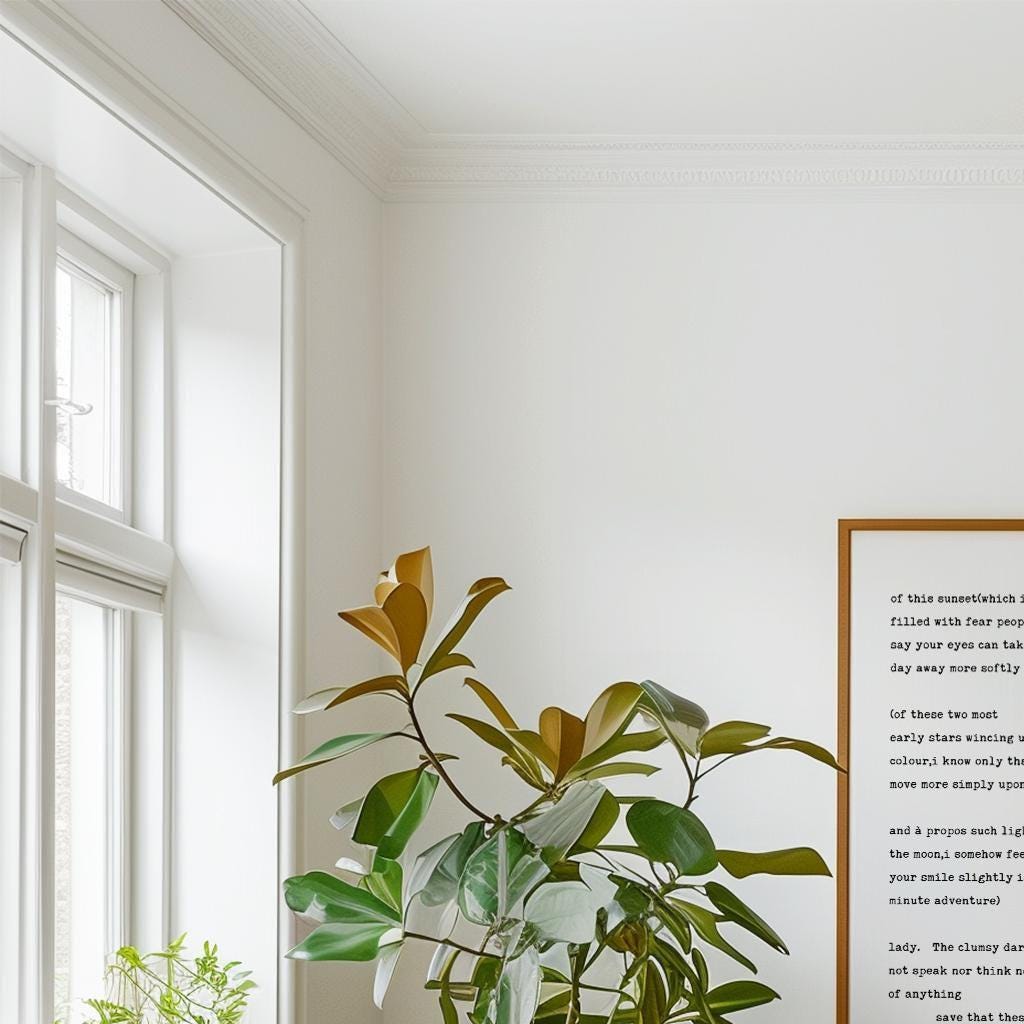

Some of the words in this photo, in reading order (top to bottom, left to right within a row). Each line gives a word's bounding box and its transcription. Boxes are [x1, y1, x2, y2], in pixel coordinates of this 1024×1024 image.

[890, 593, 904, 604] of
[907, 593, 934, 604] this
[937, 592, 1016, 604] sunset(which
[890, 616, 931, 627] filled
[933, 616, 962, 627] with
[965, 616, 993, 627] fear
[890, 640, 912, 653] say
[915, 641, 944, 652] your
[946, 641, 975, 653] eyes
[977, 641, 999, 650] can
[889, 662, 913, 676] day
[915, 664, 946, 676] away
[949, 665, 978, 673] more
[980, 662, 1021, 676] softly
[889, 708, 907, 720] (of
[910, 709, 944, 720] these
[947, 709, 968, 720] two
[971, 709, 999, 720] most
[889, 732, 925, 745] early
[928, 732, 963, 743] stars
[965, 733, 1015, 745] wincing
[889, 755, 939, 767] colour,i
[942, 755, 972, 766] know
[974, 755, 1004, 769] only
[889, 780, 918, 790] move
[920, 781, 949, 790] more
[951, 779, 995, 792] simply
[889, 825, 912, 836] and
[914, 825, 923, 835] à
[925, 827, 968, 838] propos
[970, 825, 998, 836] such
[888, 848, 910, 859] the
[912, 849, 951, 861] moon,i
[954, 849, 1003, 860] somehow
[888, 873, 918, 885] your
[920, 872, 955, 882] smile
[957, 872, 1014, 885] slightly
[888, 895, 931, 905] minute
[933, 895, 1001, 906] adventure)
[888, 941, 921, 955] lady.
[931, 942, 955, 952] The
[957, 942, 1000, 955] clumsy
[888, 965, 909, 976] not
[911, 965, 948, 978] speak
[951, 968, 973, 976] nor
[975, 965, 1012, 976] think
[888, 988, 902, 999] of
[904, 989, 962, 1001] anything
[935, 1013, 964, 1022] save
[966, 1011, 995, 1022] that
